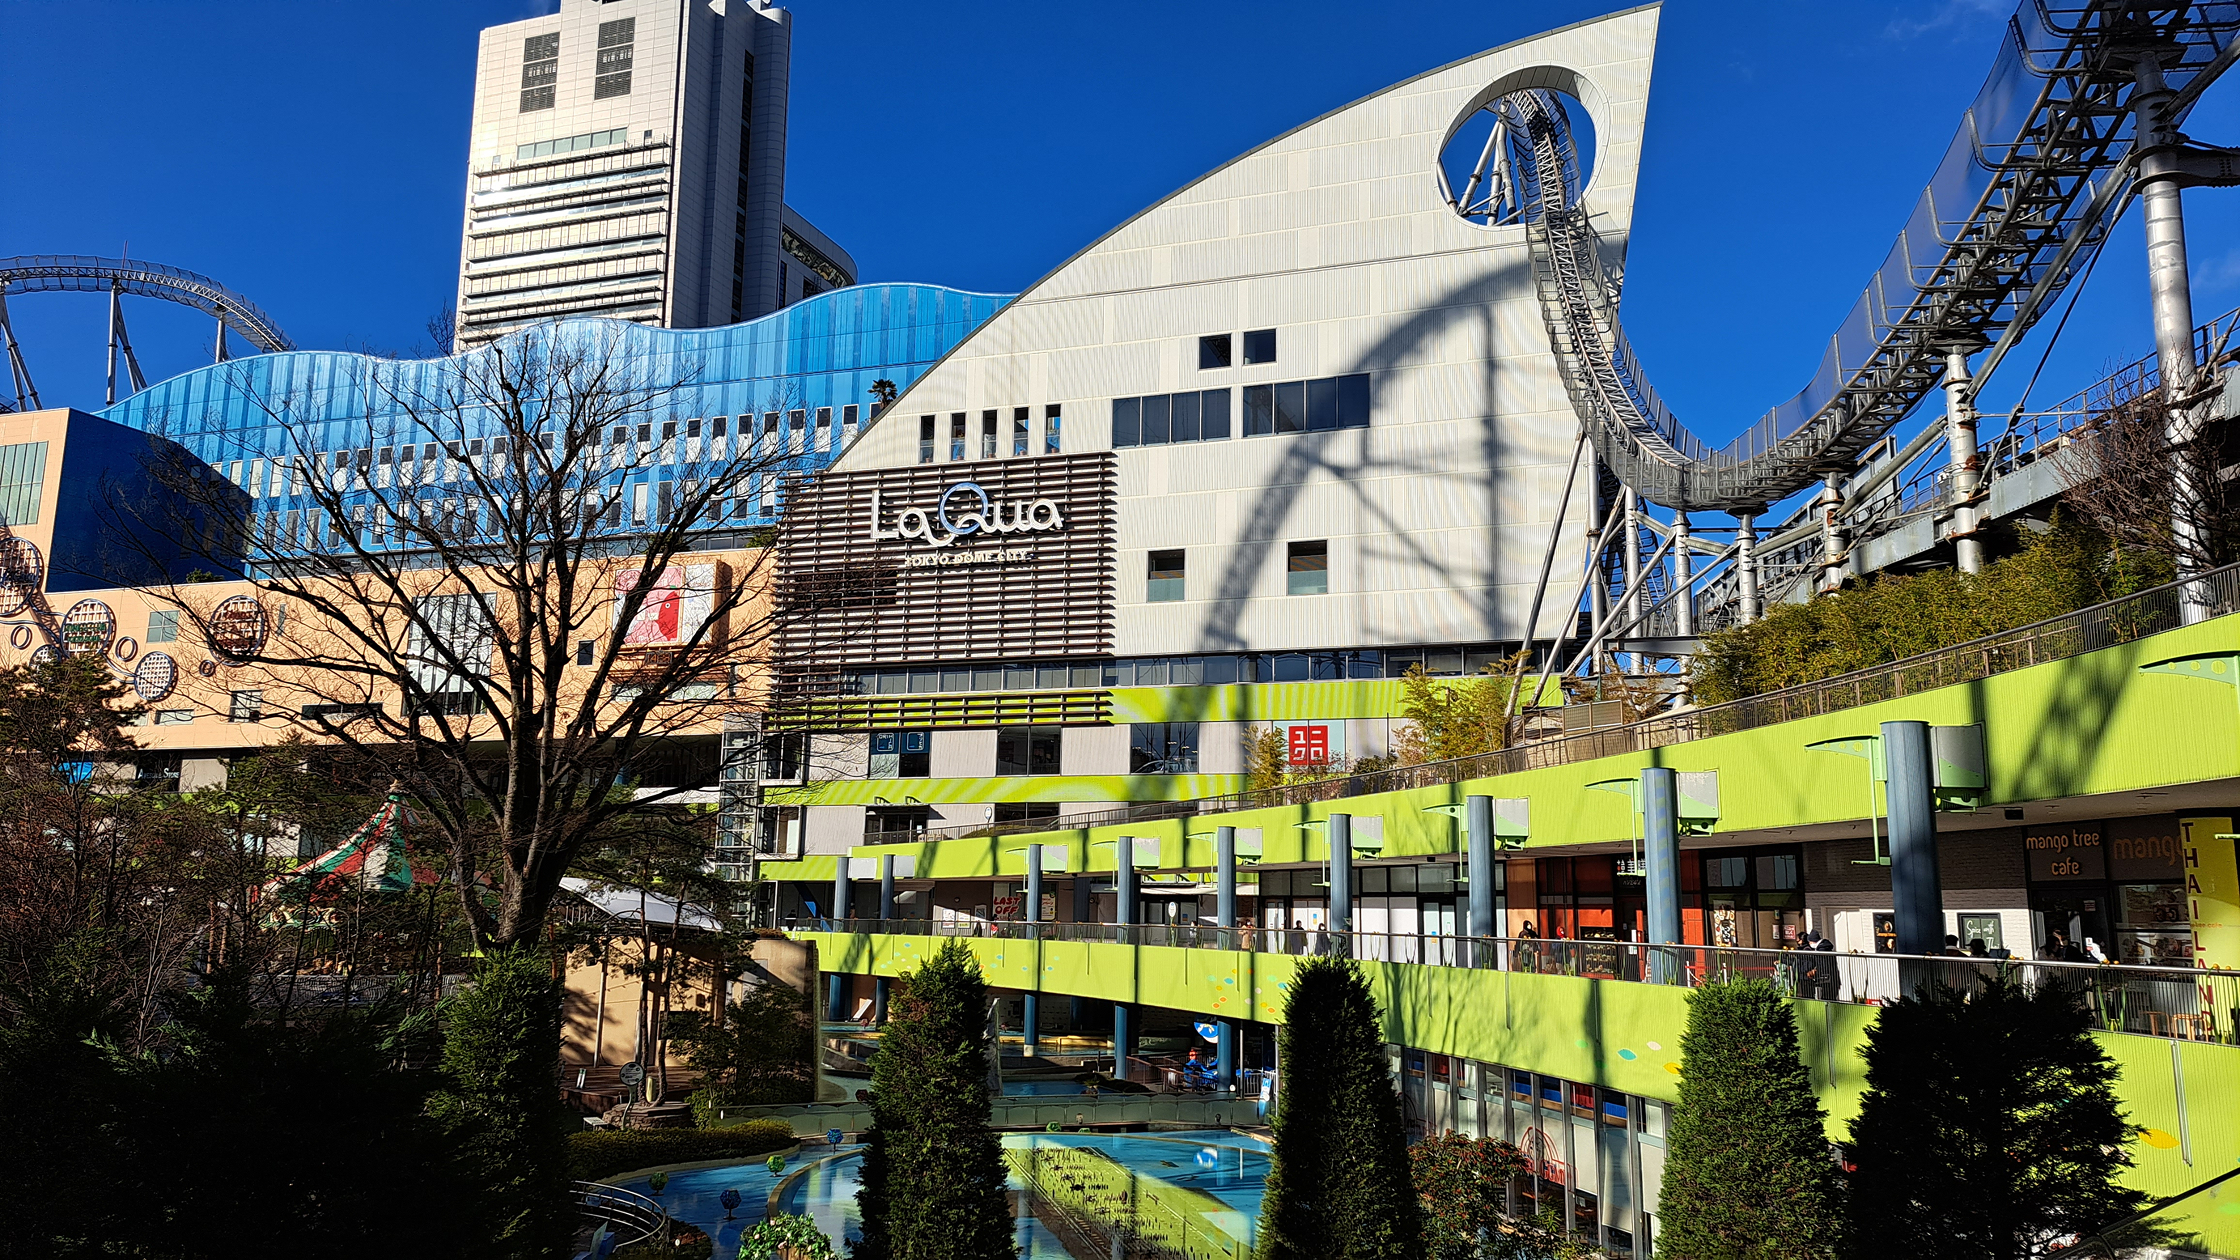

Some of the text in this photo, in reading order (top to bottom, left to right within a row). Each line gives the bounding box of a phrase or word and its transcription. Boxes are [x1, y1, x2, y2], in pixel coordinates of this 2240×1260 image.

[870, 482, 1064, 547] LaQua
[905, 550, 1028, 567] TOKYO DOME CITY
[2026, 834, 2069, 853] mango
[2072, 829, 2100, 847] tree
[2051, 857, 2080, 876] cafe
[993, 897, 1021, 905] LAST
[994, 906, 1019, 915] OFF
